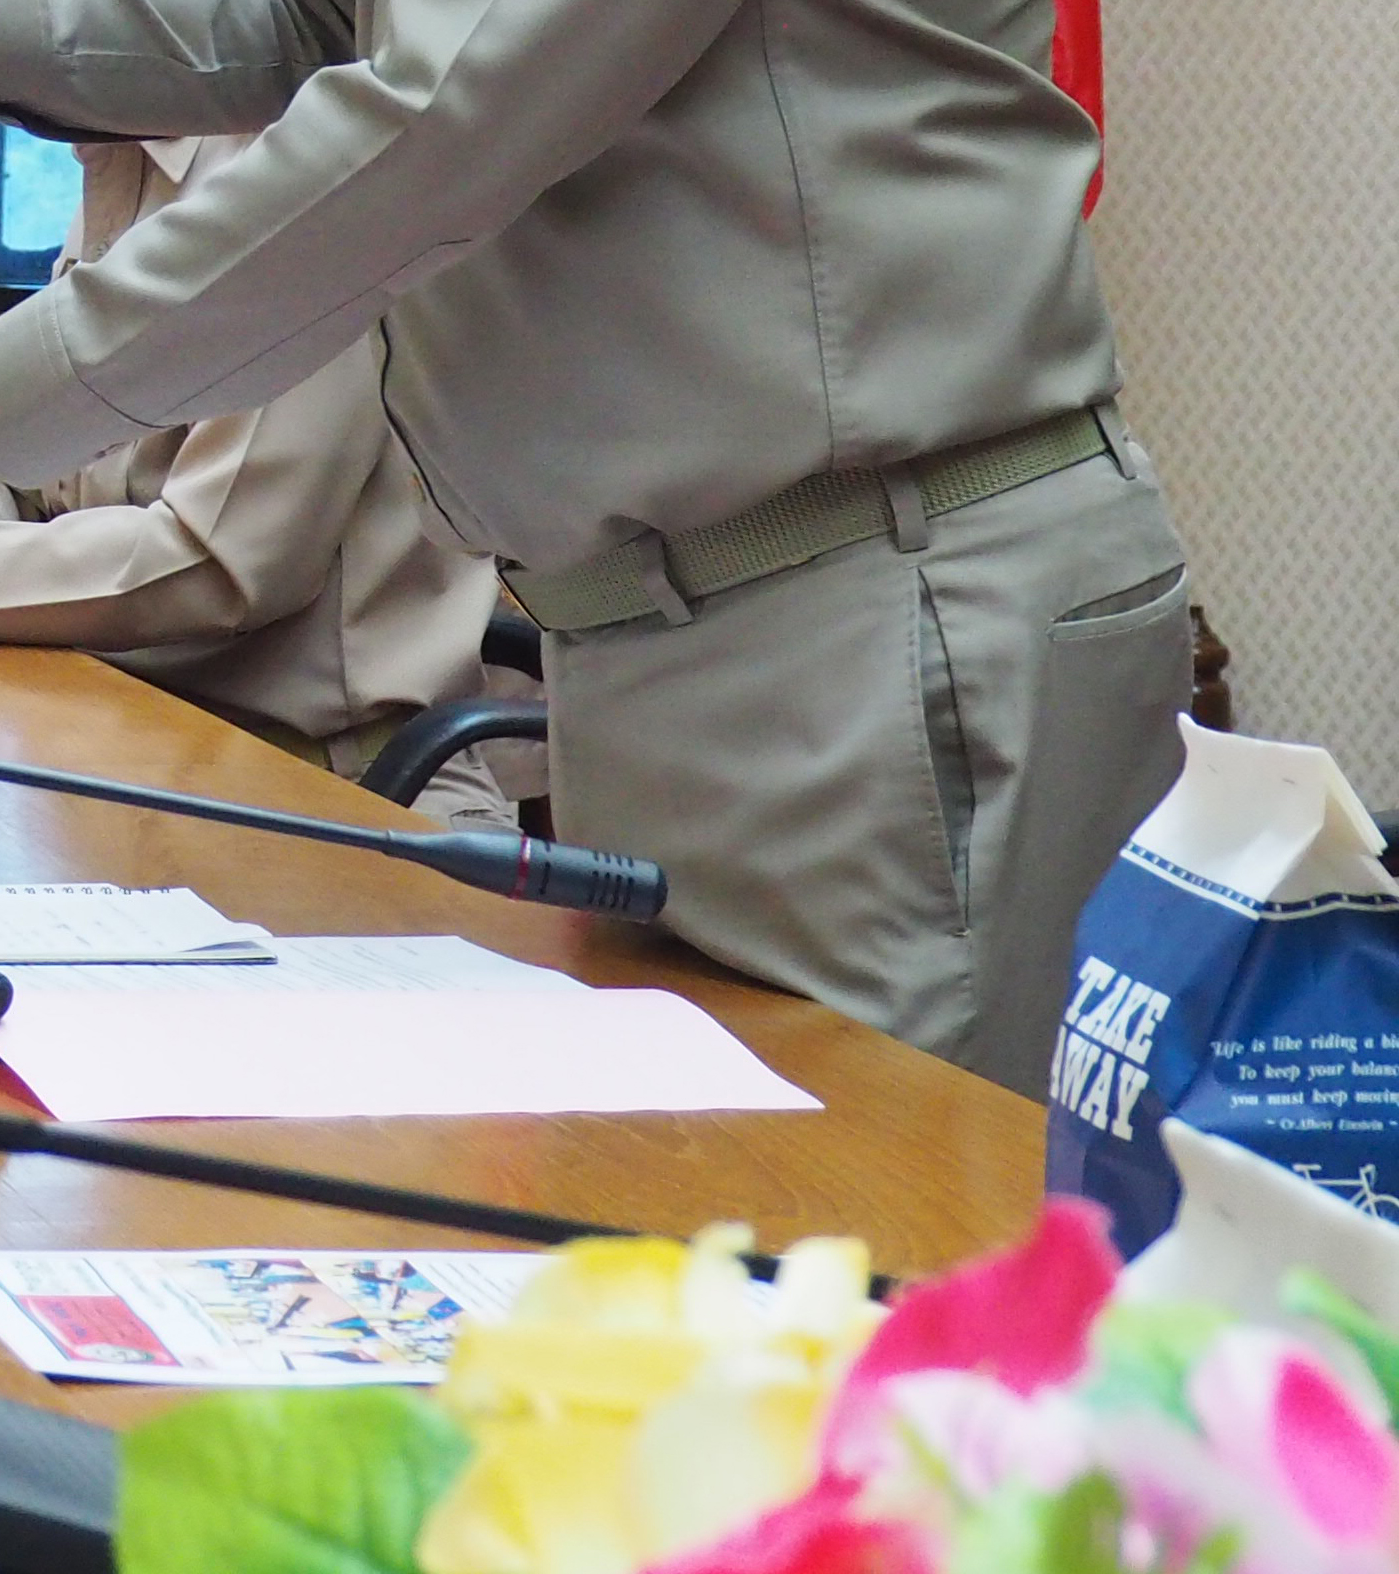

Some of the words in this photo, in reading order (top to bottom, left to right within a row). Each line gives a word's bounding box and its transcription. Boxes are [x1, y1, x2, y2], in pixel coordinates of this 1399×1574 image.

[1065, 956, 1171, 1065] TAKE
[1252, 1038, 1266, 1053] is
[1272, 1035, 1303, 1051] like
[1310, 1033, 1358, 1053] riding
[1364, 1037, 1374, 1049] a
[1239, 1064, 1257, 1080] To
[1264, 1064, 1301, 1082] keep
[1307, 1064, 1345, 1081] your
[1230, 1094, 1259, 1109] you
[1267, 1091, 1304, 1105] must
[1312, 1088, 1349, 1107] keep
